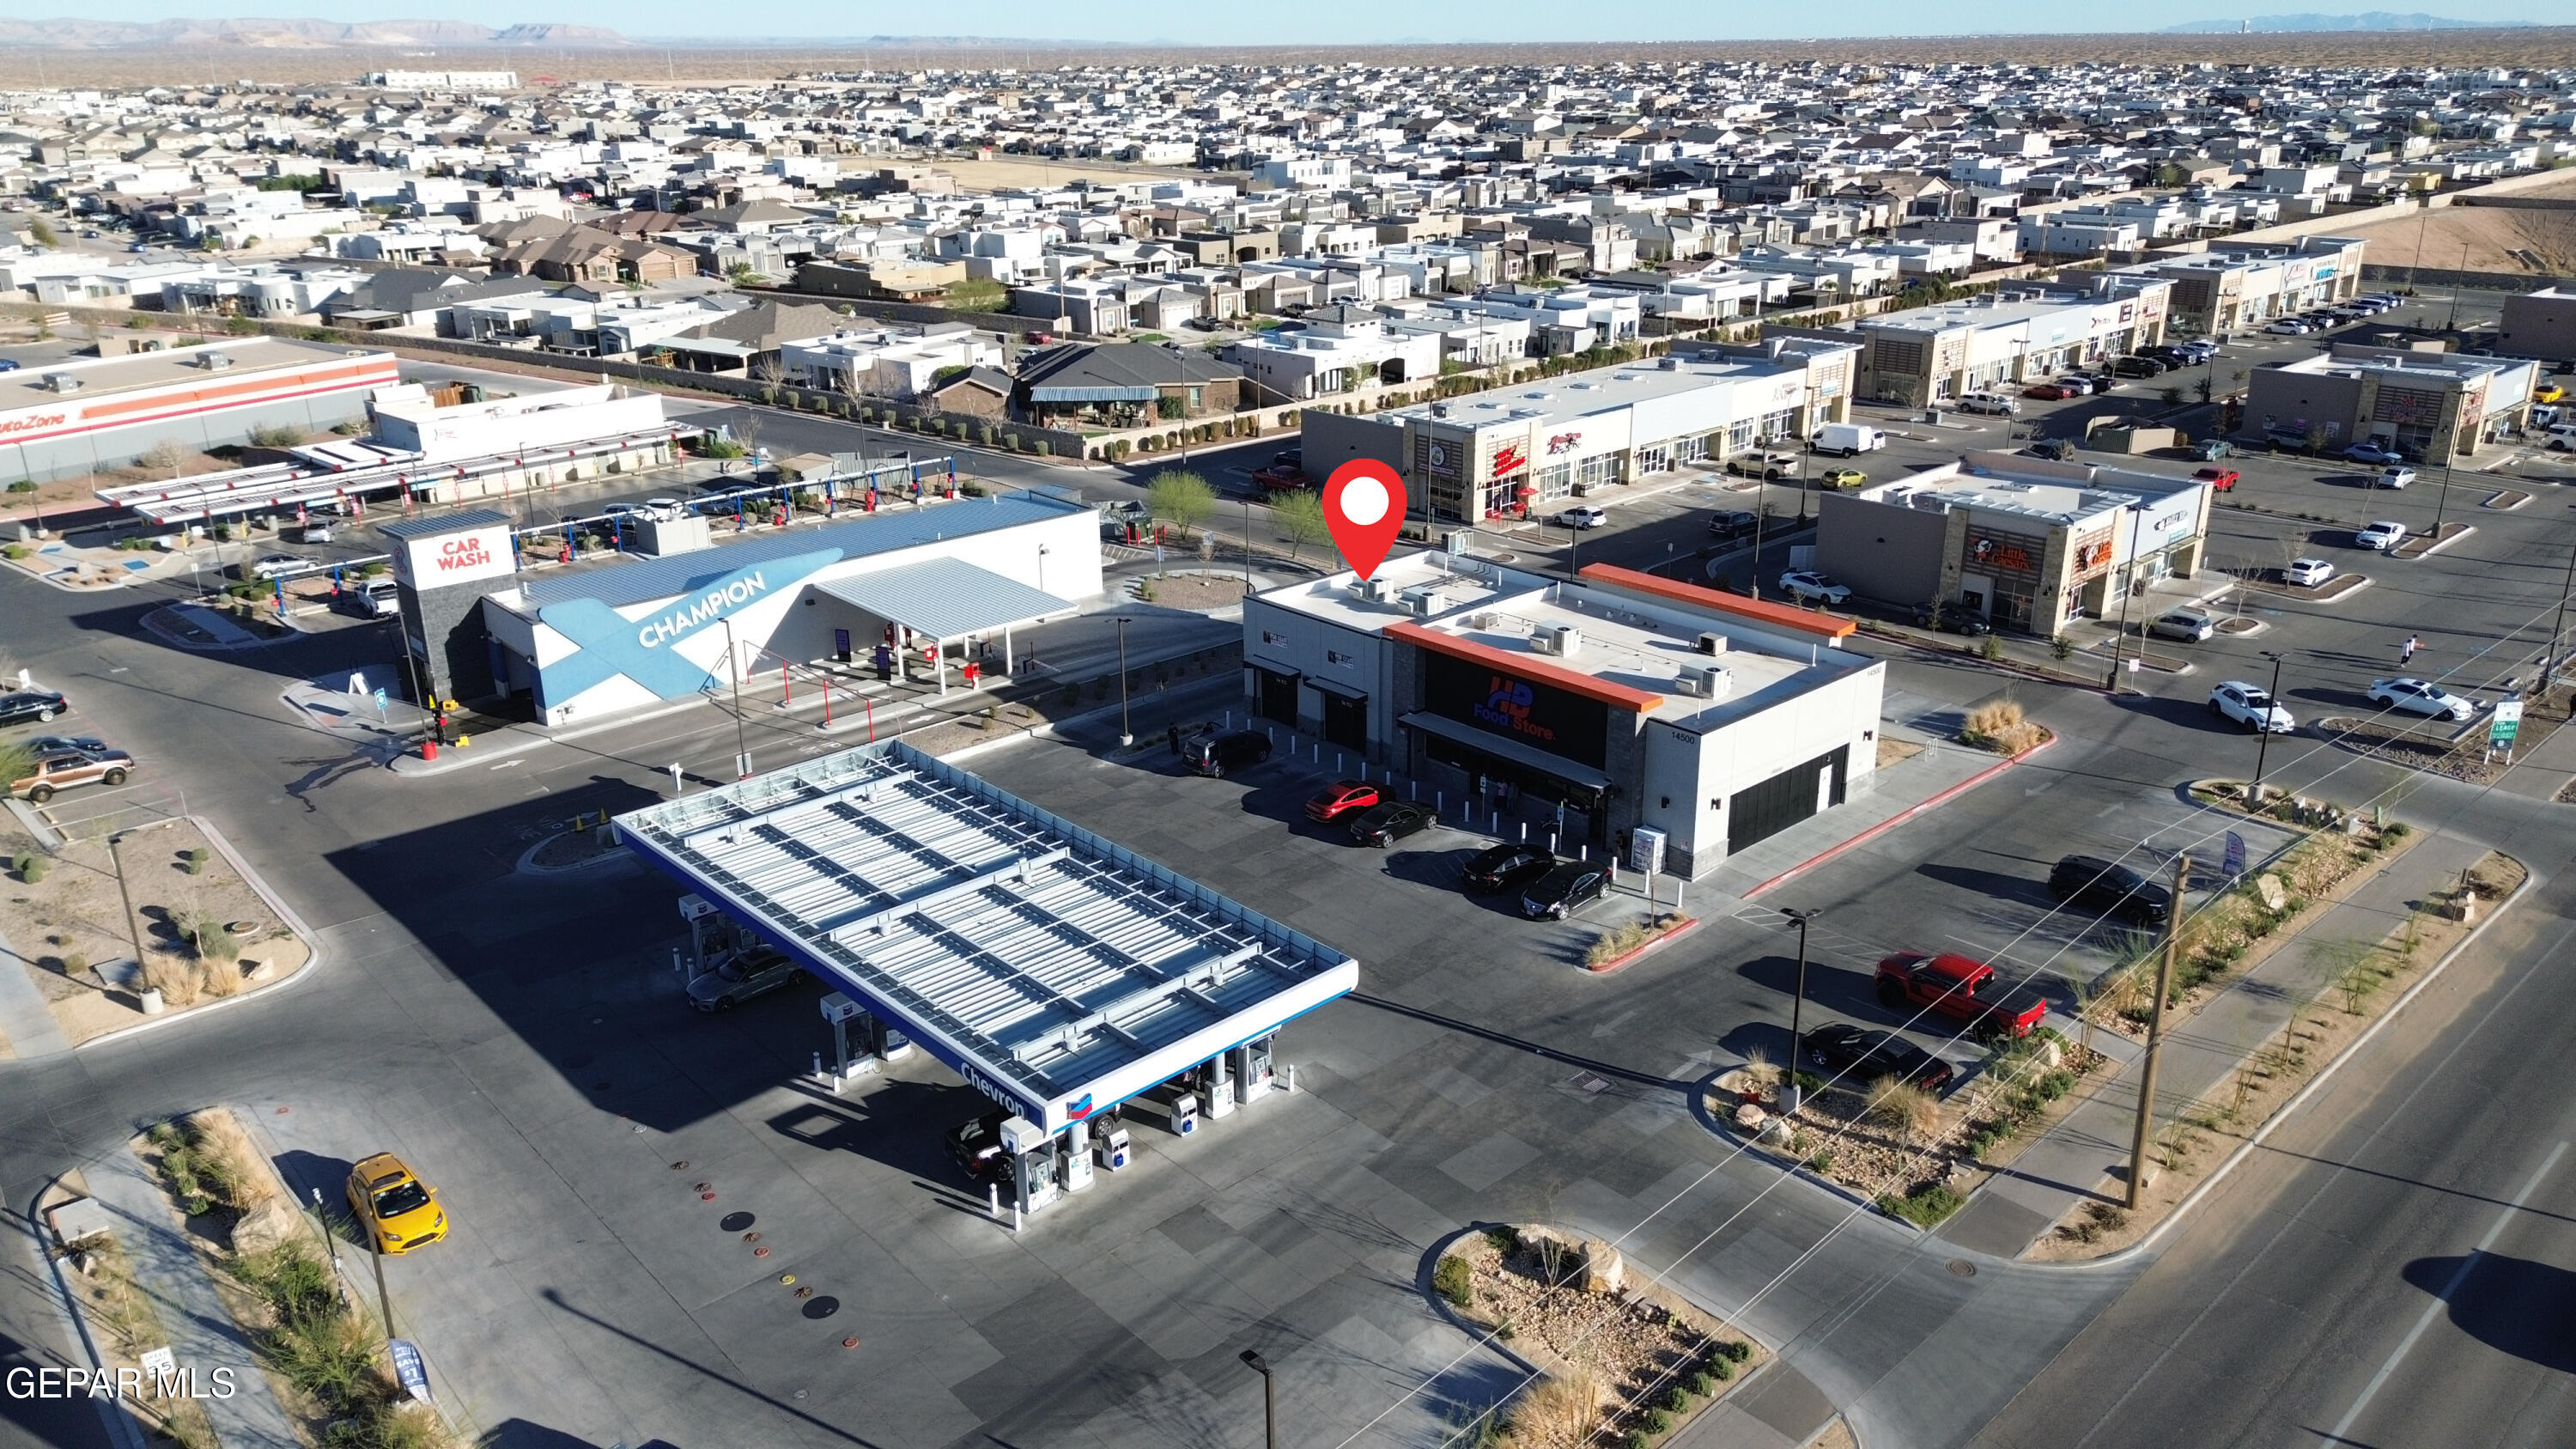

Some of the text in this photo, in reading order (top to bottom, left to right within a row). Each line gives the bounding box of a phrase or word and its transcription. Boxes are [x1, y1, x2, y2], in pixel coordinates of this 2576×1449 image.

[0, 414, 65, 433] utoZone
[442, 538, 480, 556] CAR
[2000, 545, 2027, 559] Little
[437, 551, 491, 570] WASH
[1991, 554, 2031, 570] Caesars
[638, 570, 766, 648] CHAMPION
[1473, 703, 1509, 726] Food
[1671, 731, 1695, 745] 14500
[961, 1062, 1026, 1121] Chevron
[149, 1361, 172, 1375] 35
[396, 1358, 420, 1368] SAVE
